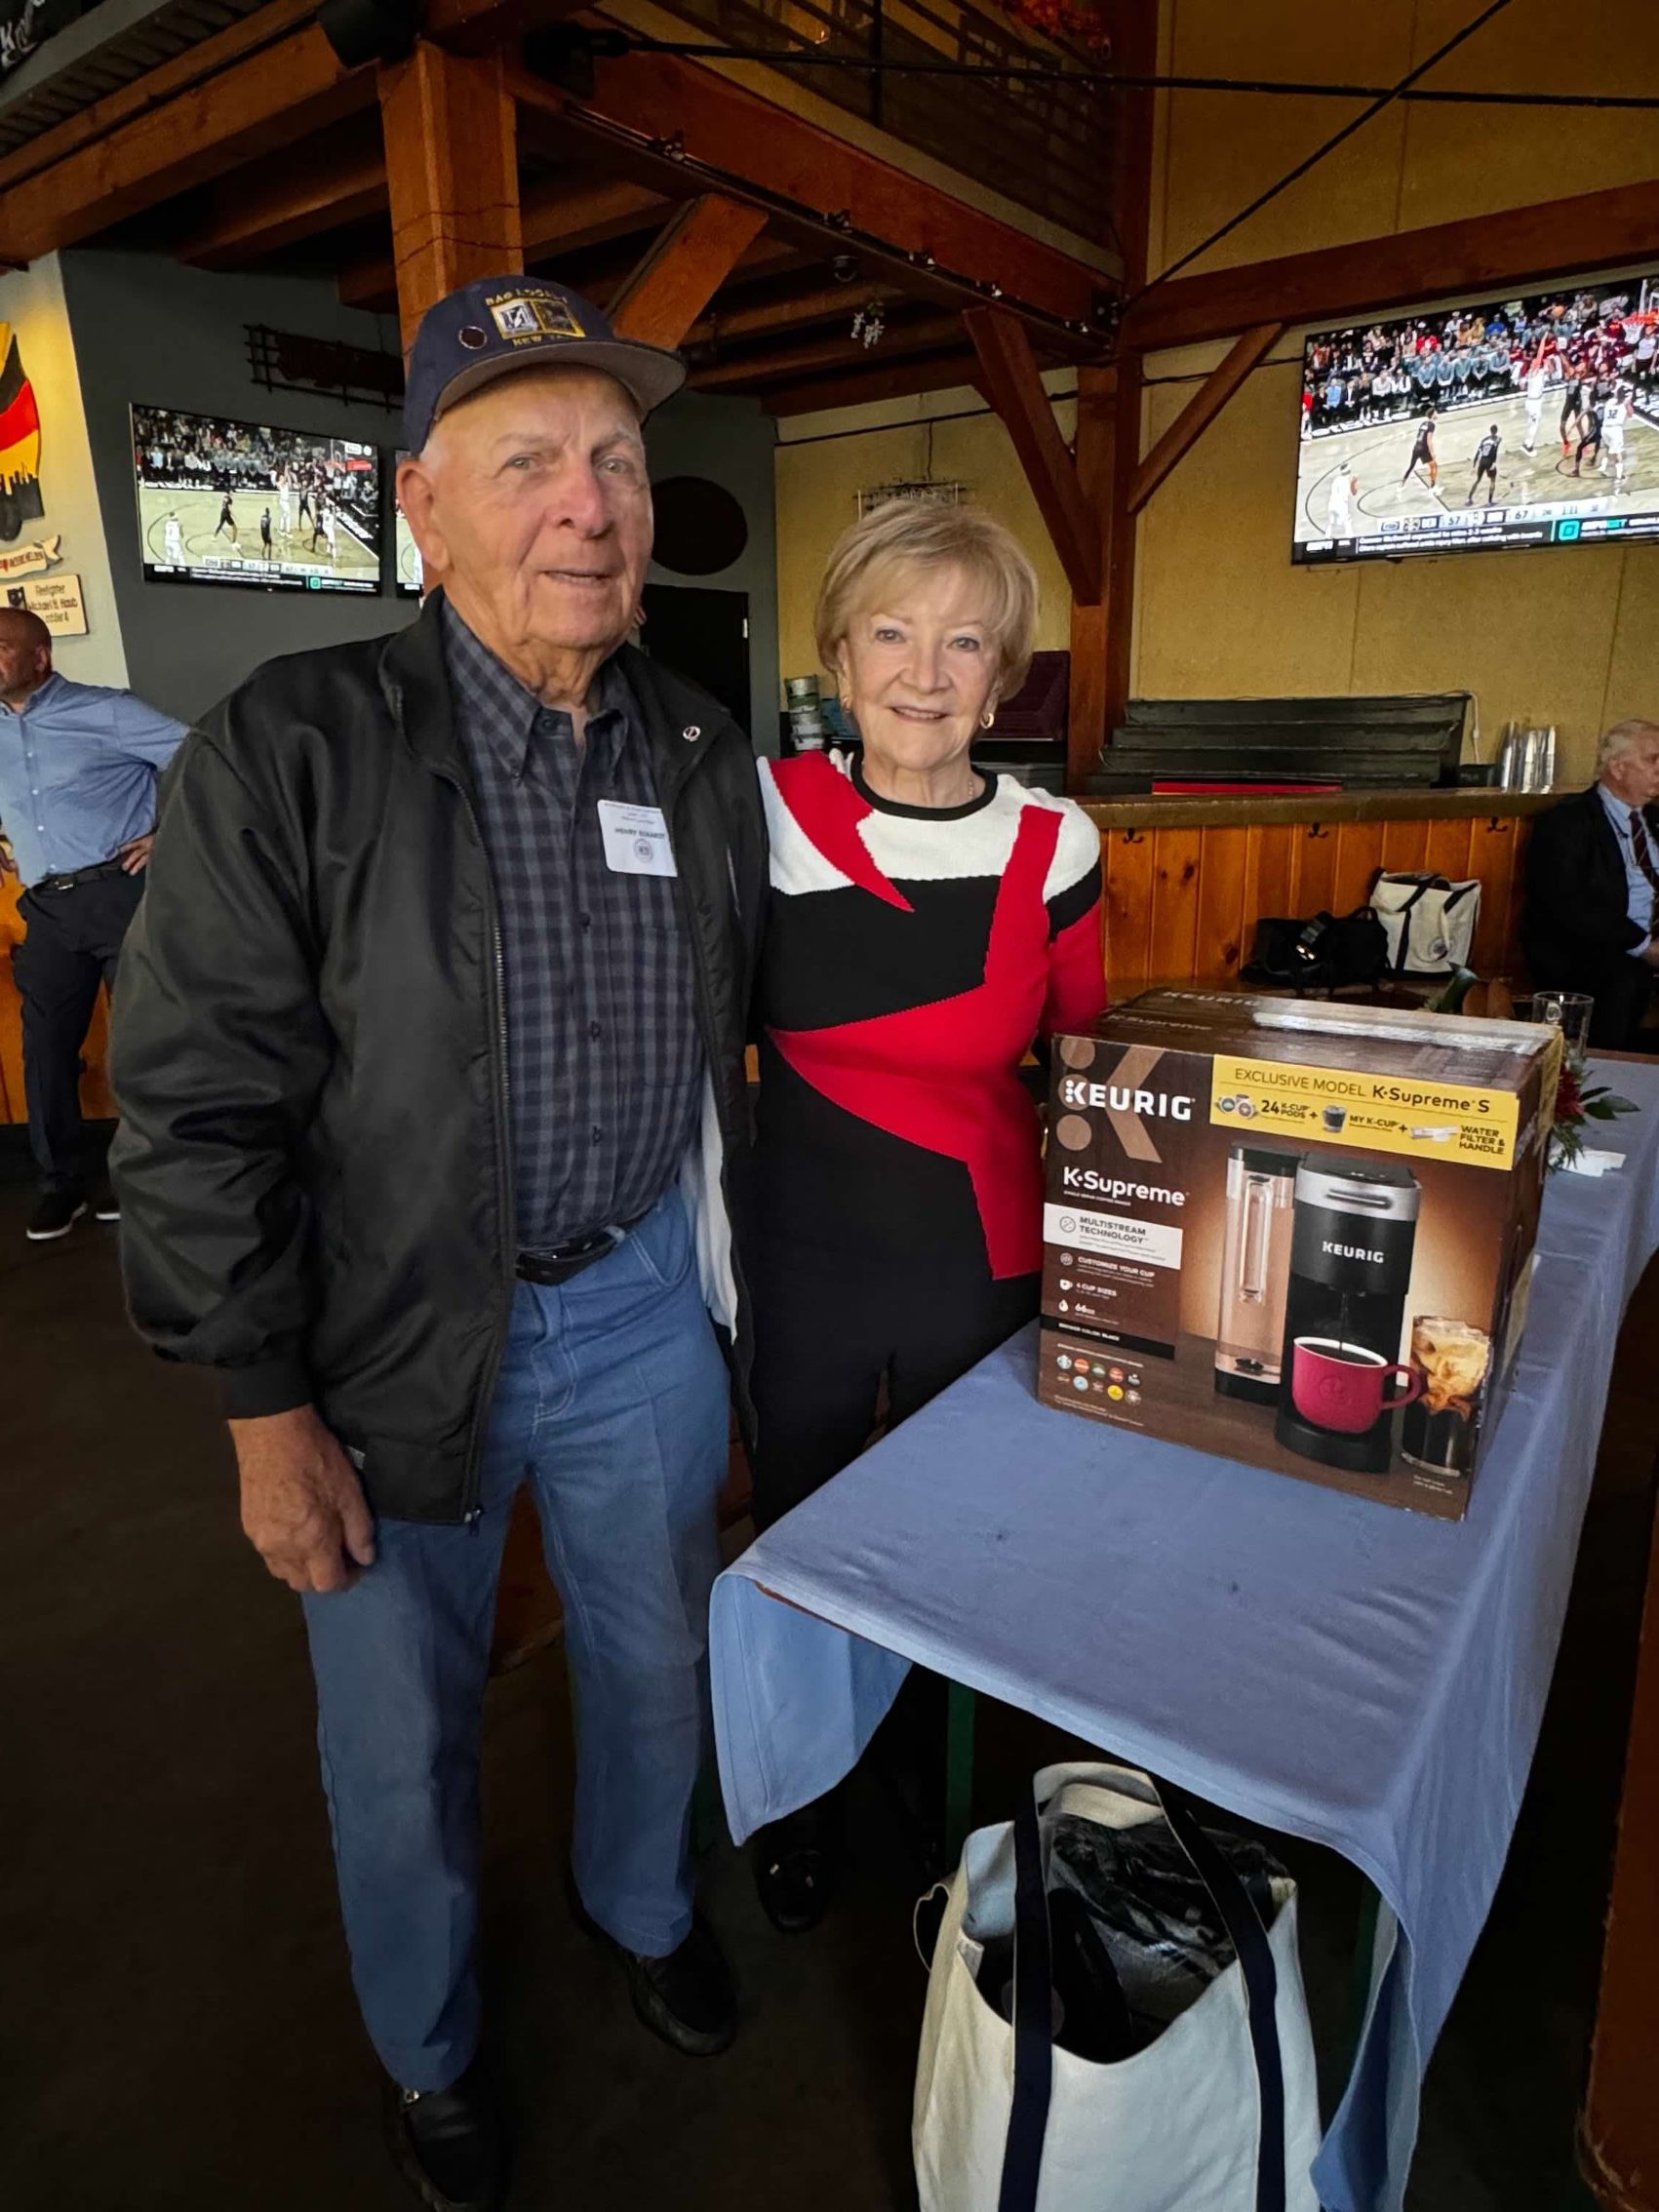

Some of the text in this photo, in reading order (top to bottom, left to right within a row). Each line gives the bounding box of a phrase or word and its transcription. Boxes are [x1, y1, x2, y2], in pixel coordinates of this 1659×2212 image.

[1515, 510, 1529, 520] 67
[1163, 991, 1262, 1007] KEURIG
[1064, 1080, 1193, 1121] KEURIG
[1235, 1068, 1310, 1089] EXCLUSIVE
[1313, 1078, 1366, 1097] MODEL
[1478, 1099, 1490, 1114] S
[1261, 1099, 1280, 1115] 24
[1349, 1115, 1364, 1124] MY
[1460, 1125, 1500, 1138] WATER
[1281, 1110, 1307, 1120] PODS
[1459, 1142, 1505, 1155] HANDLE
[1460, 1133, 1506, 1147] FILTER &
[1079, 1216, 1147, 1236] MULTISTREAM
[1079, 1224, 1145, 1244] TECHNOLOGY
[1322, 1241, 1384, 1263] KEURIG
[1077, 1256, 1119, 1271] CUSTOMIZE
[1119, 1265, 1139, 1276] YOUR
[1139, 1269, 1156, 1278] CUP
[1081, 1283, 1096, 1291] CUP
[1096, 1286, 1117, 1297] SIZES
